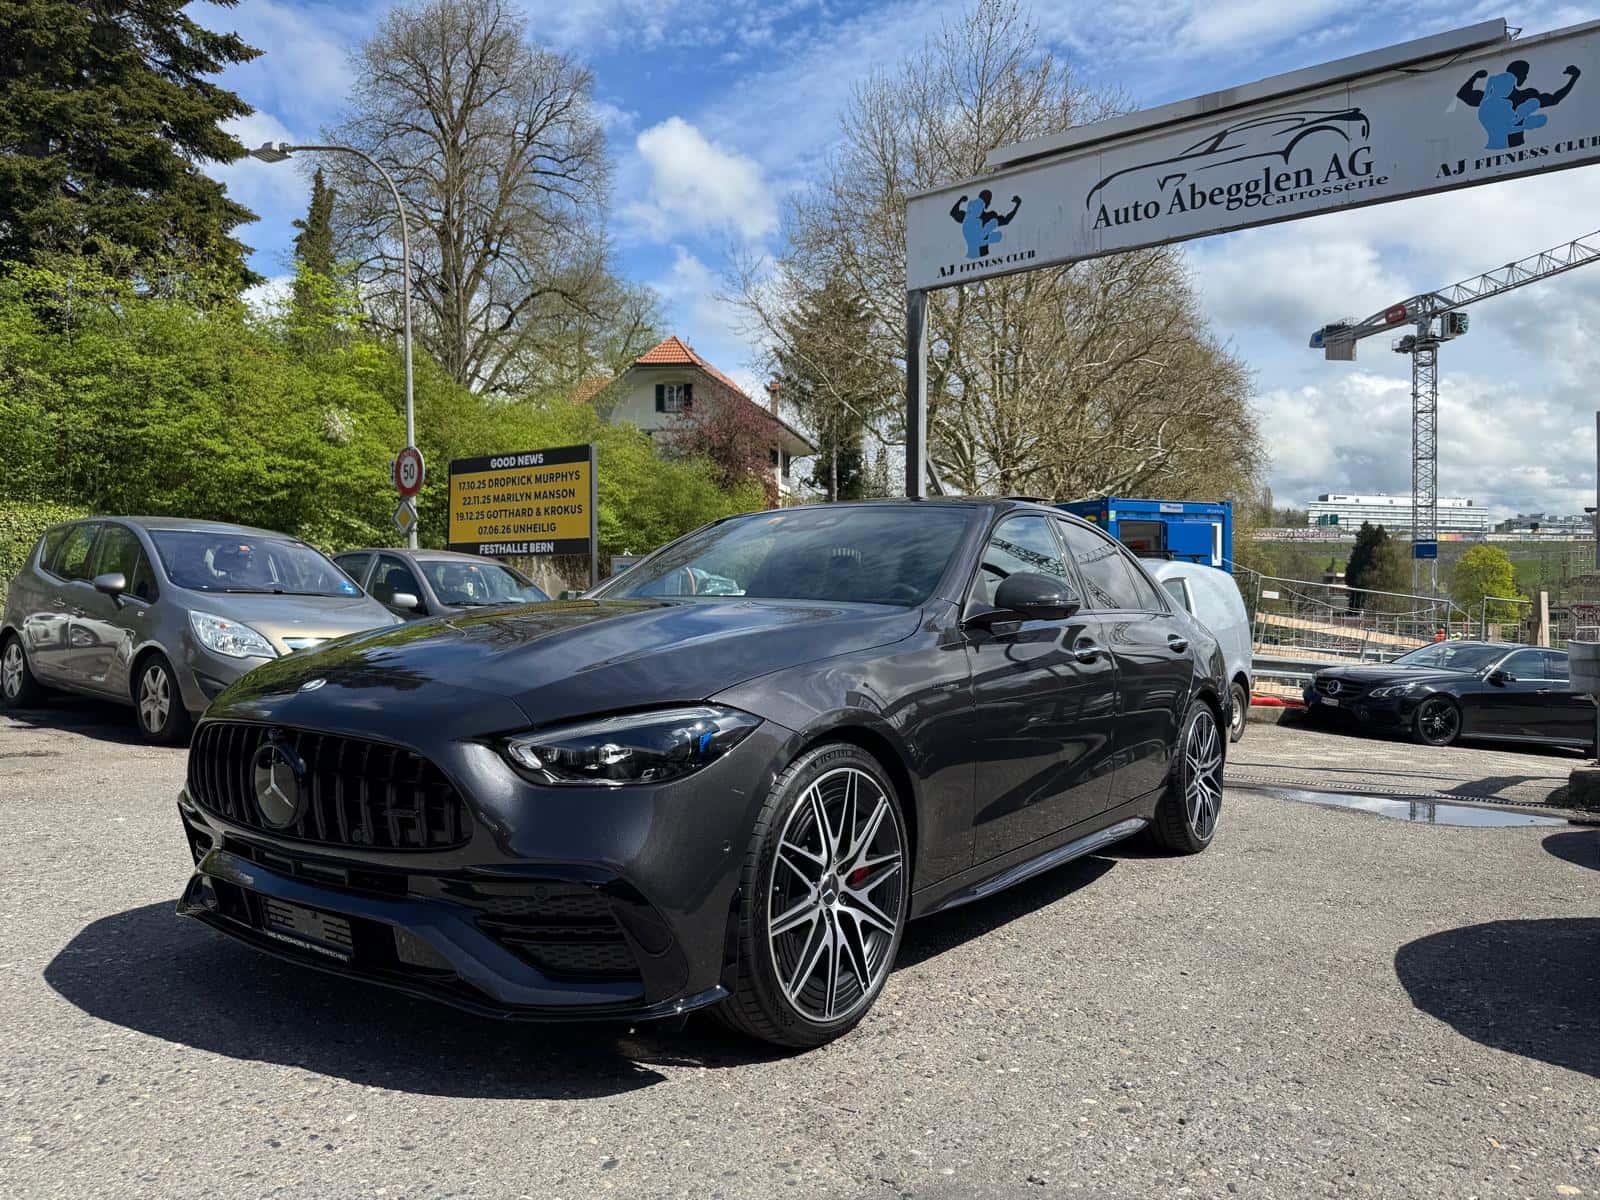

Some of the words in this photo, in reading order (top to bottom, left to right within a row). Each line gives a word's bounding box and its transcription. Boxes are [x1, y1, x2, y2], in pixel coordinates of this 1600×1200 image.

[1435, 158, 1466, 179] AJ
[1474, 145, 1550, 171] FITNESS
[1092, 200, 1161, 230] Auto
[1166, 166, 1315, 215] Abegglen
[1322, 145, 1375, 183] AG
[1261, 173, 1390, 207] Carrosserie
[936, 264, 955, 279] AJ
[960, 256, 1003, 273] FITNESS
[1006, 249, 1036, 264] CLUB
[490, 456, 516, 469] GOOD
[517, 452, 544, 466] NEWS
[403, 463, 415, 480] 50
[488, 474, 533, 488] DROPKICK
[534, 469, 581, 484] MURPHYS
[462, 494, 492, 506] 22.11.25
[492, 491, 532, 504] MARILYN
[534, 487, 576, 500] MANSON
[455, 511, 485, 521] 19.12.25
[486, 507, 534, 520] GOTTHARD
[535, 507, 542, 517] &
[544, 504, 583, 516] KROKUS
[513, 522, 557, 534] UNHEILIG
[479, 542, 528, 555] FESTHALLE
[529, 541, 554, 553] BERN
